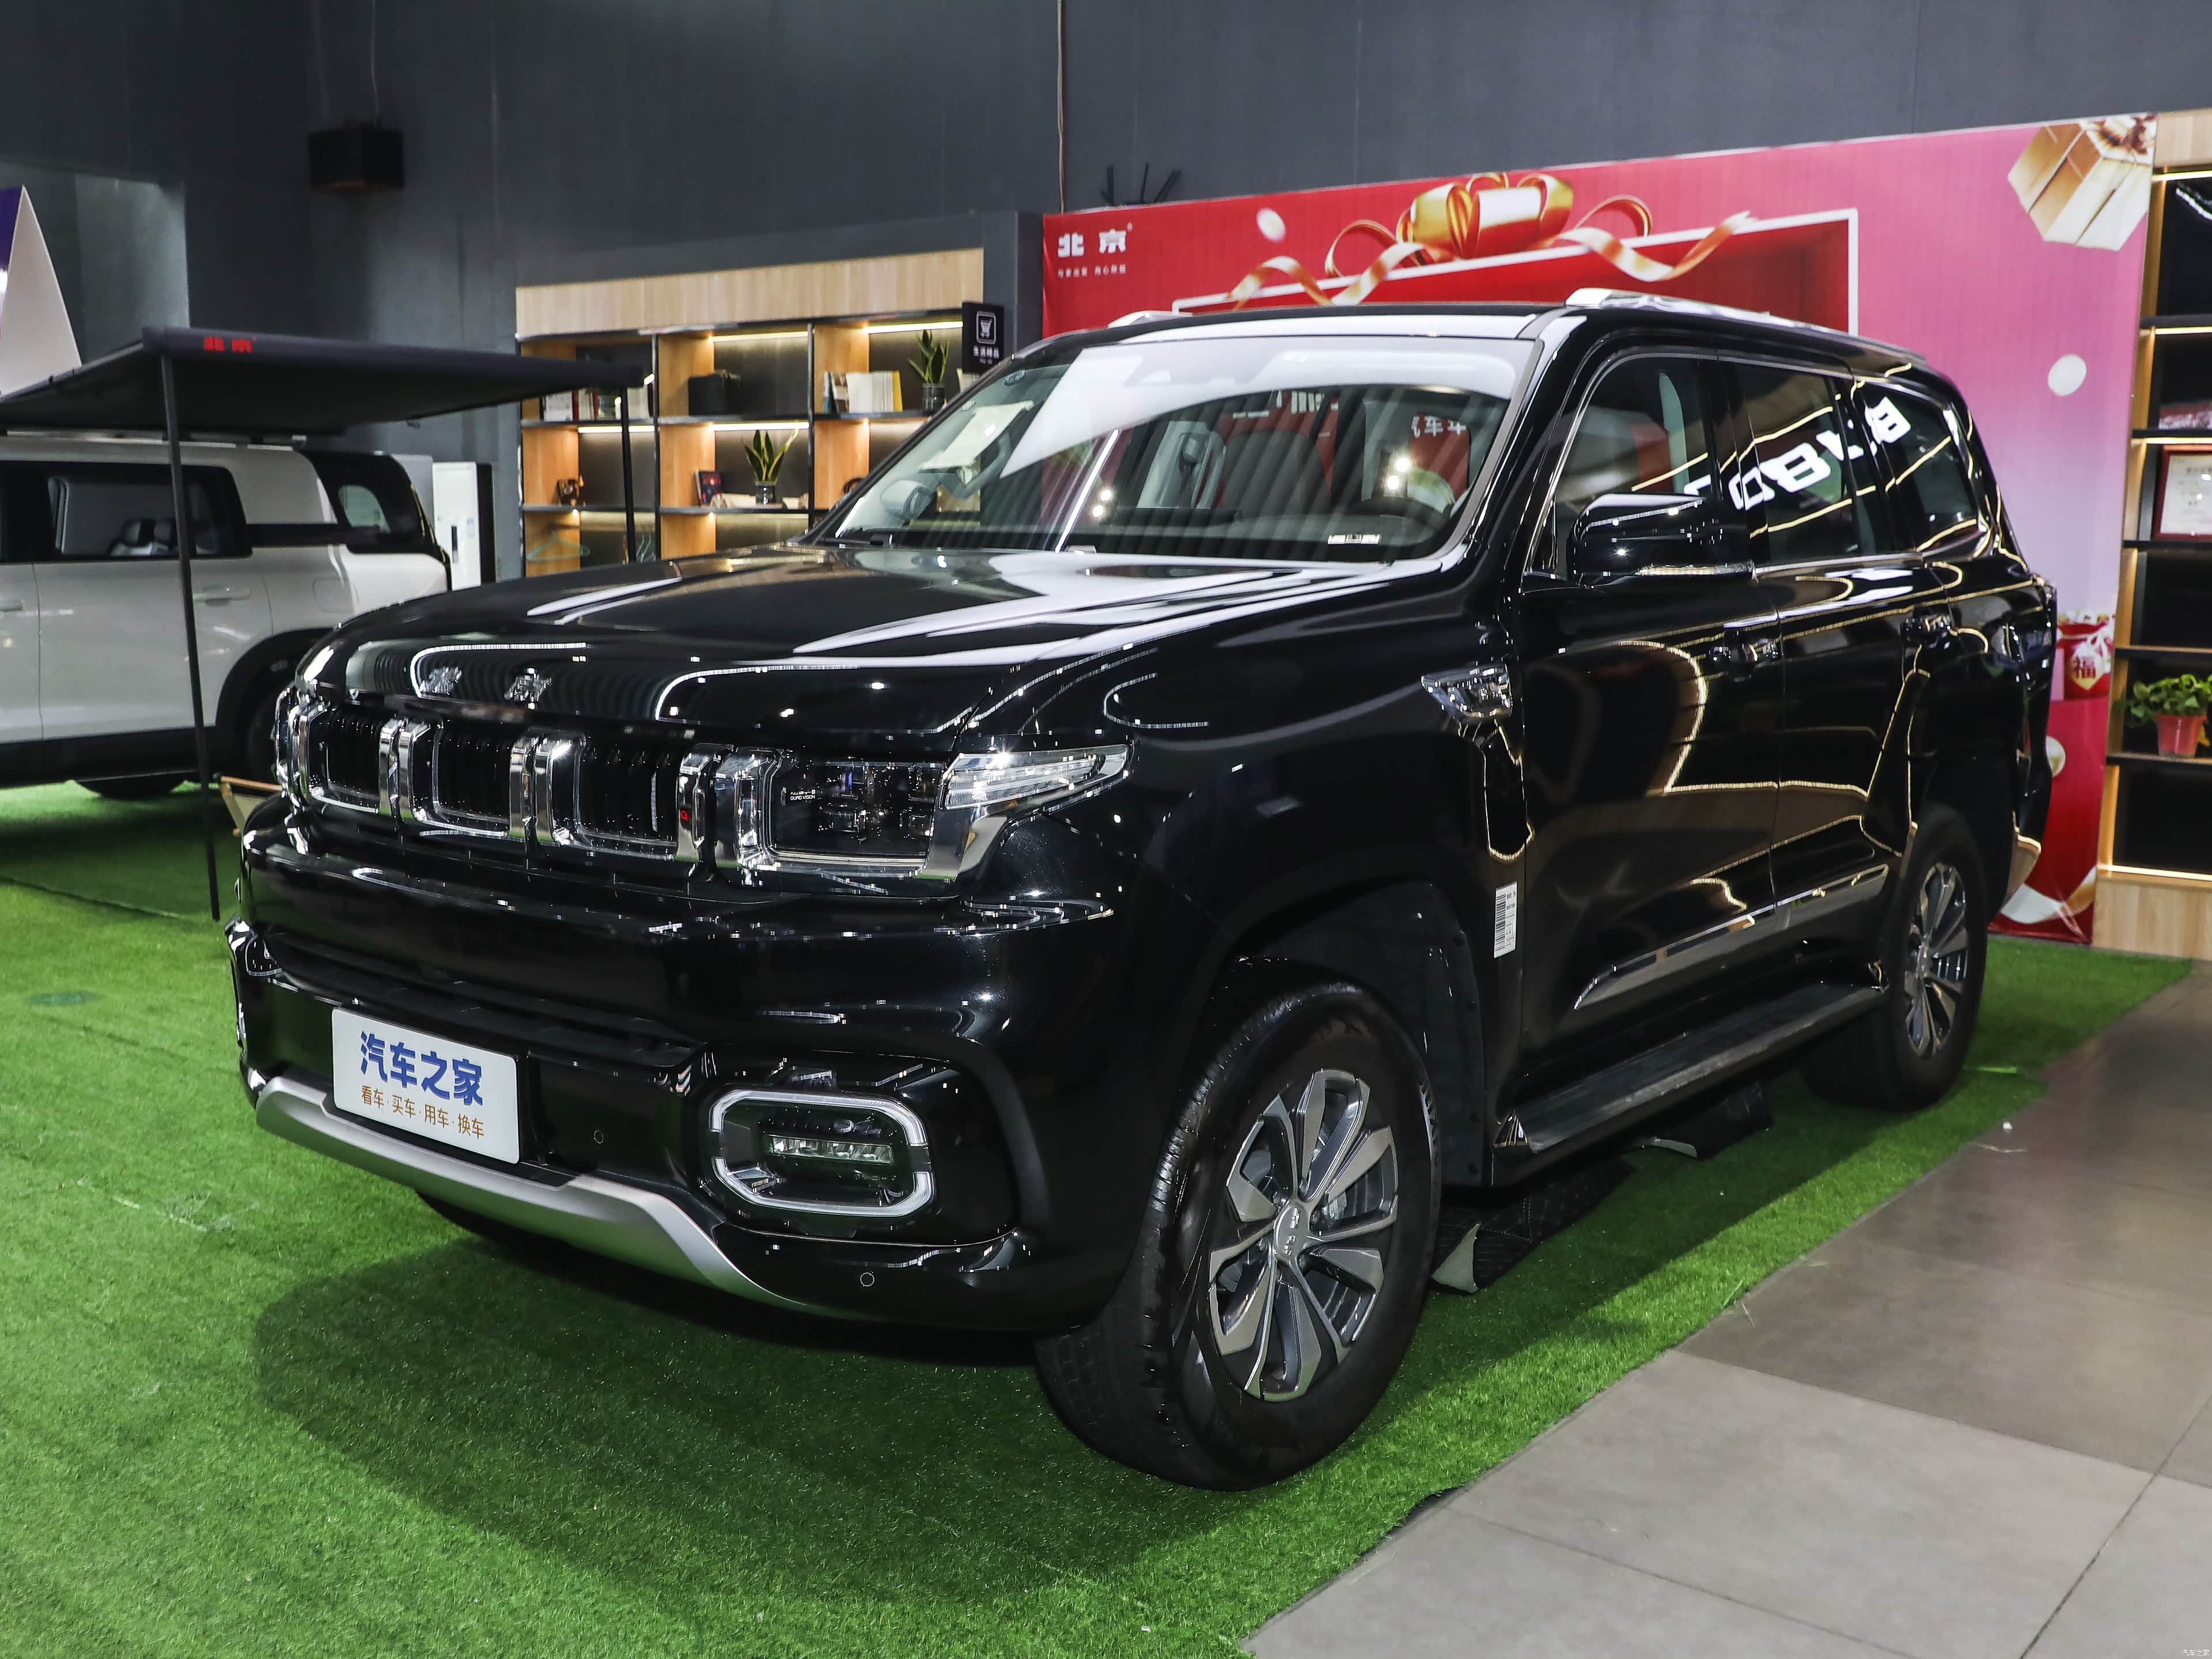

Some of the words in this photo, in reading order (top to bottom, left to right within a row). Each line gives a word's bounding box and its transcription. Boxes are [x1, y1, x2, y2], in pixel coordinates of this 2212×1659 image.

[1058, 229, 1127, 257] 北京
[2074, 656, 2096, 679] 福
[361, 1031, 483, 1106] 汽车之家
